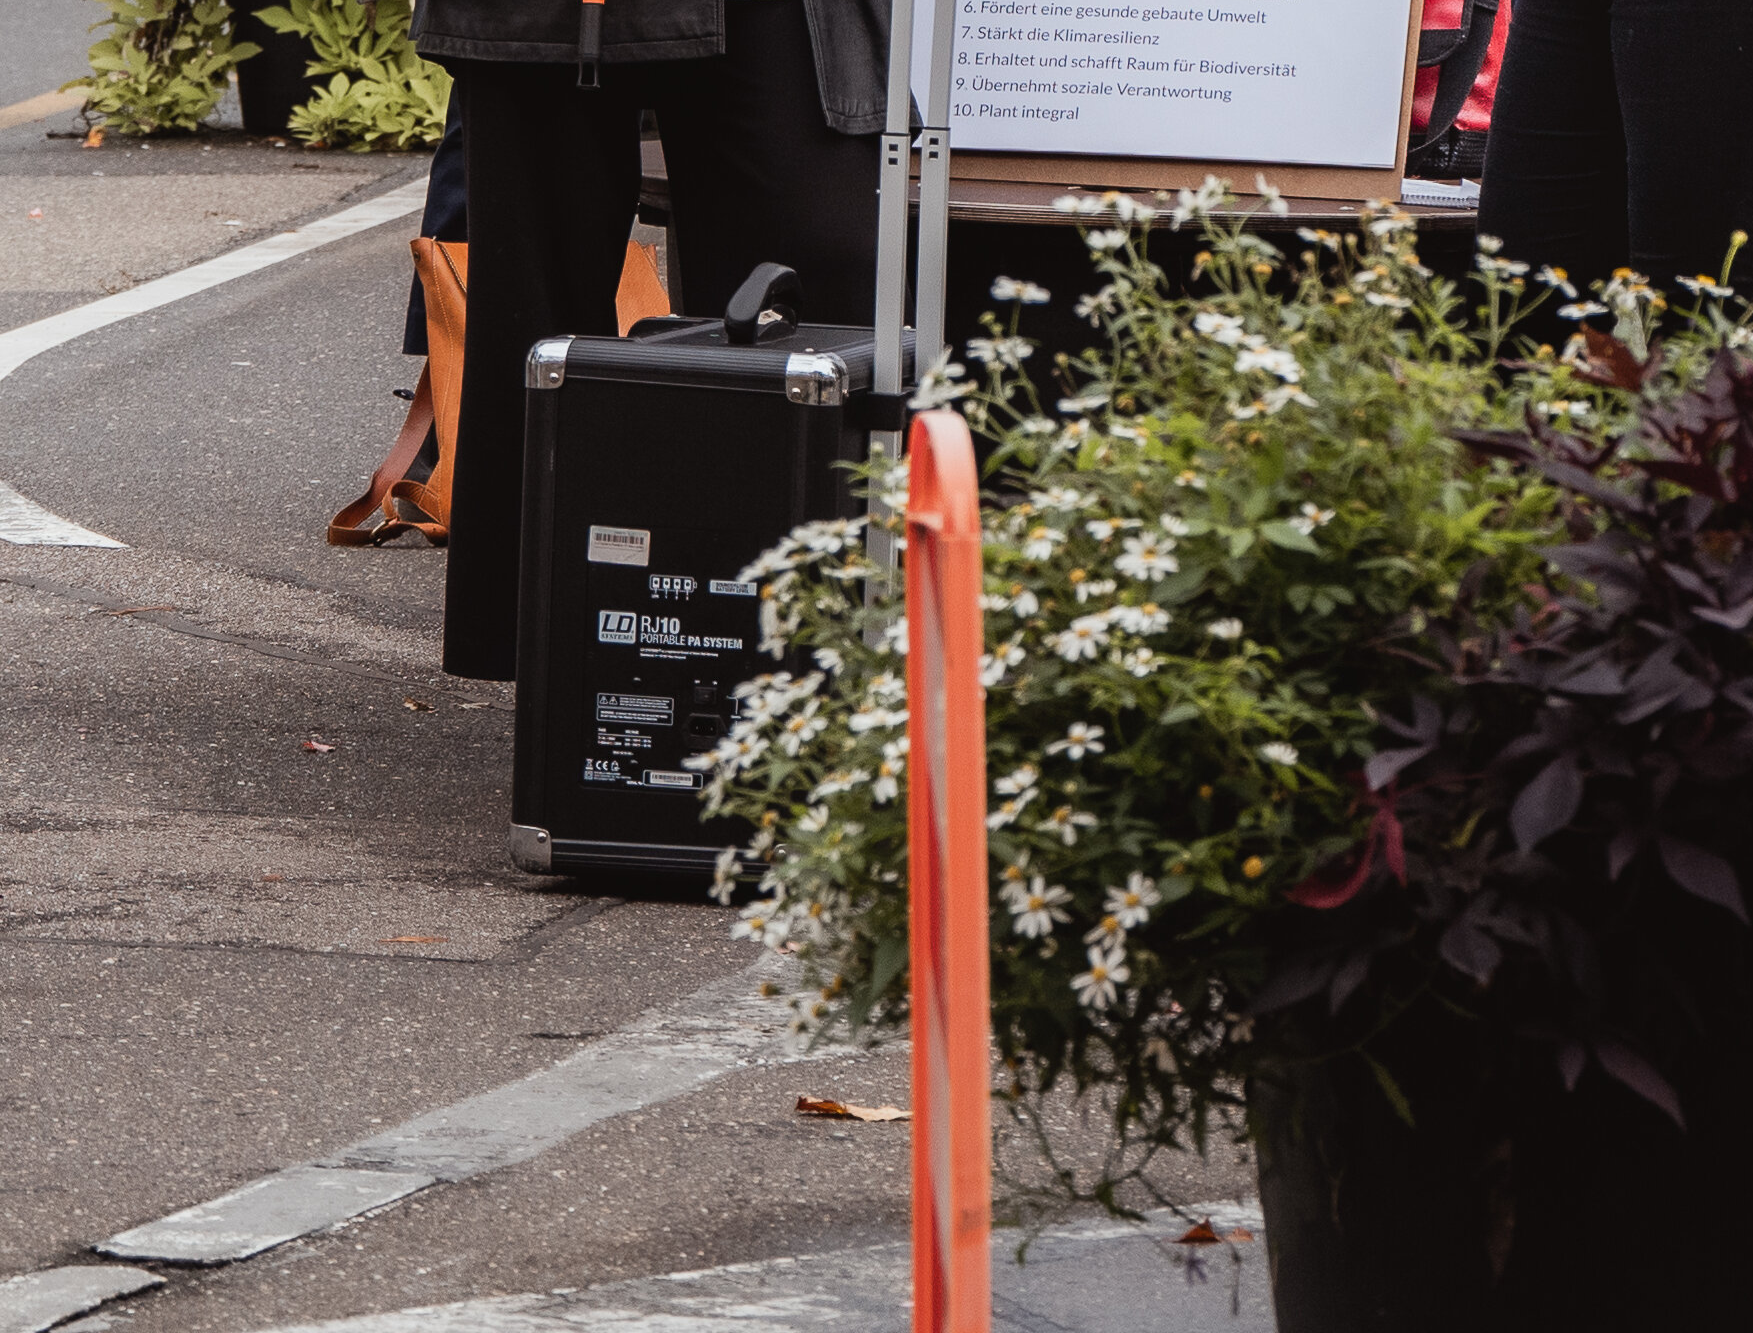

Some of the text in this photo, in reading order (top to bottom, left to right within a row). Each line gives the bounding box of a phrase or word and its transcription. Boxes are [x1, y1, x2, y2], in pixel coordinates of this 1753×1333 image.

[963, 0, 1267, 24] 6. Fördert eine gesunde gebaute Umwelt
[961, 25, 1160, 46] 7. Stärkt die Klimaresilienz
[957, 51, 1297, 78] 8. Erhaltet und schafft Raum für Biodiversität
[955, 74, 1233, 102] 9. Übernehmt soziale Verantwortung
[953, 103, 1080, 123] 10. Plant integral
[601, 614, 635, 634] LD
[641, 615, 681, 634] RJ10
[640, 633, 743, 650] PORTABLE PA SYSTEM
